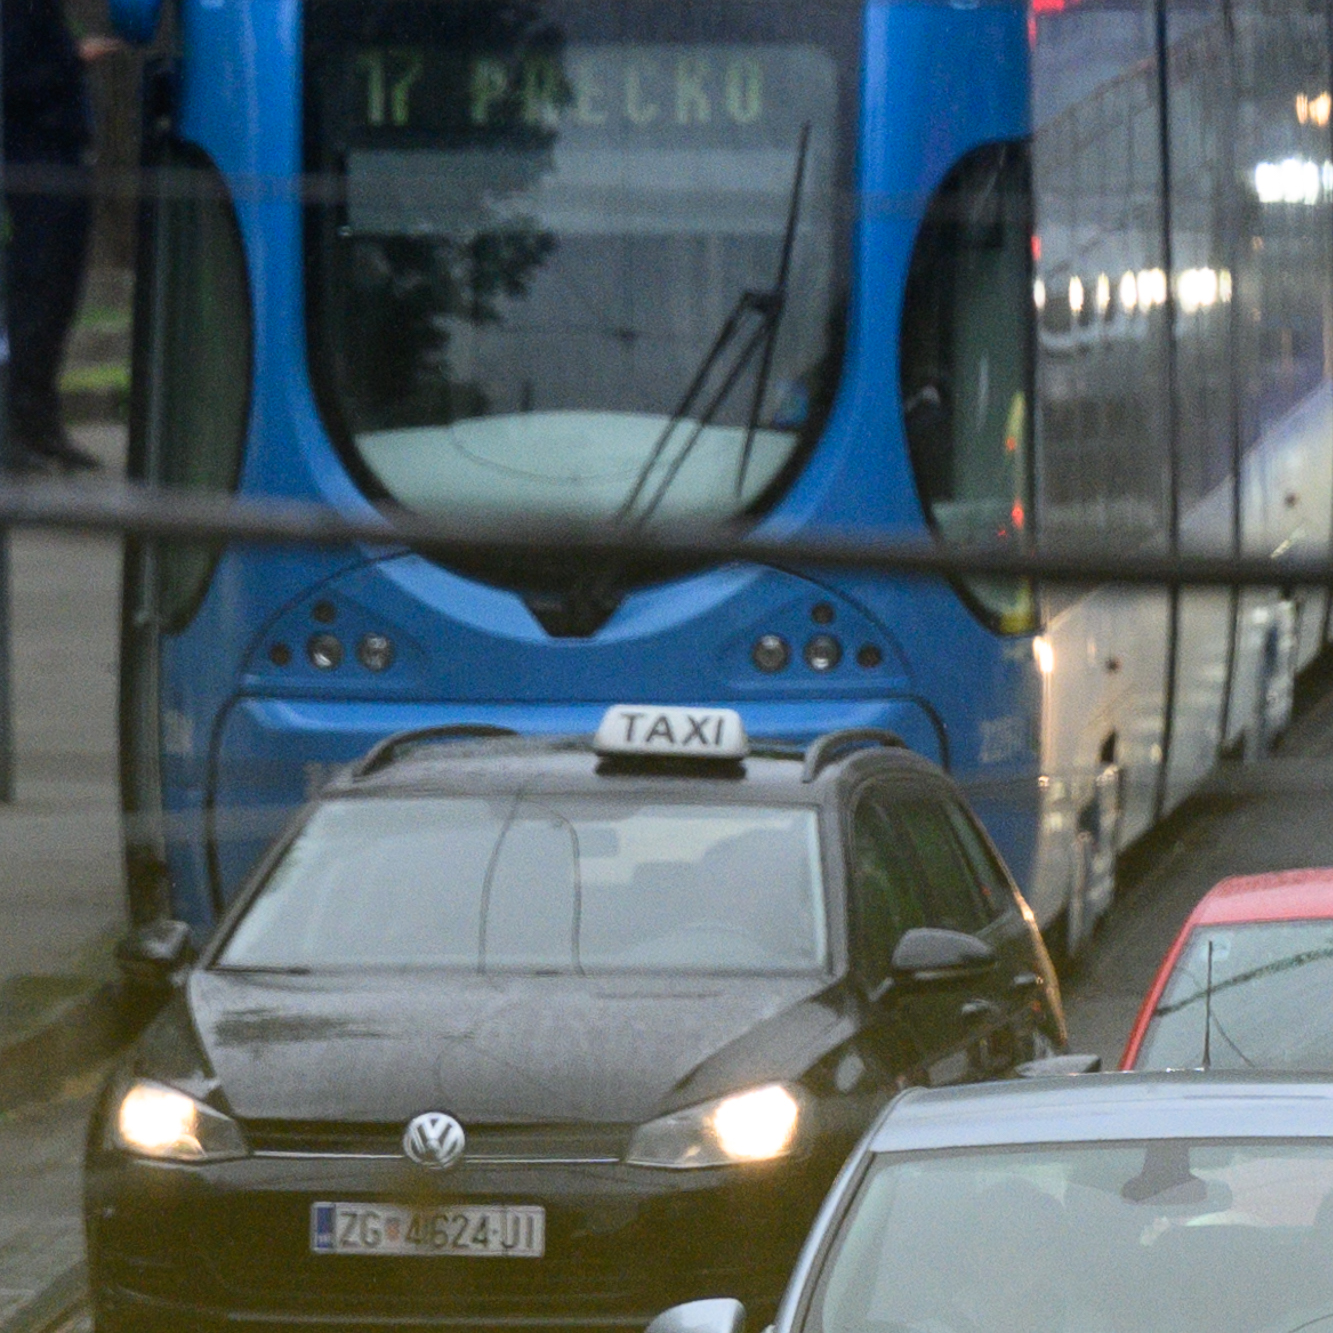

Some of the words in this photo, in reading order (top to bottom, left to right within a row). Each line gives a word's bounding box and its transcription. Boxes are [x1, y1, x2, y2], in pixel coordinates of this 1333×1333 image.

[359, 48, 424, 126] 17
[620, 713, 724, 745] TAXI
[340, 1211, 383, 1247] ZG
